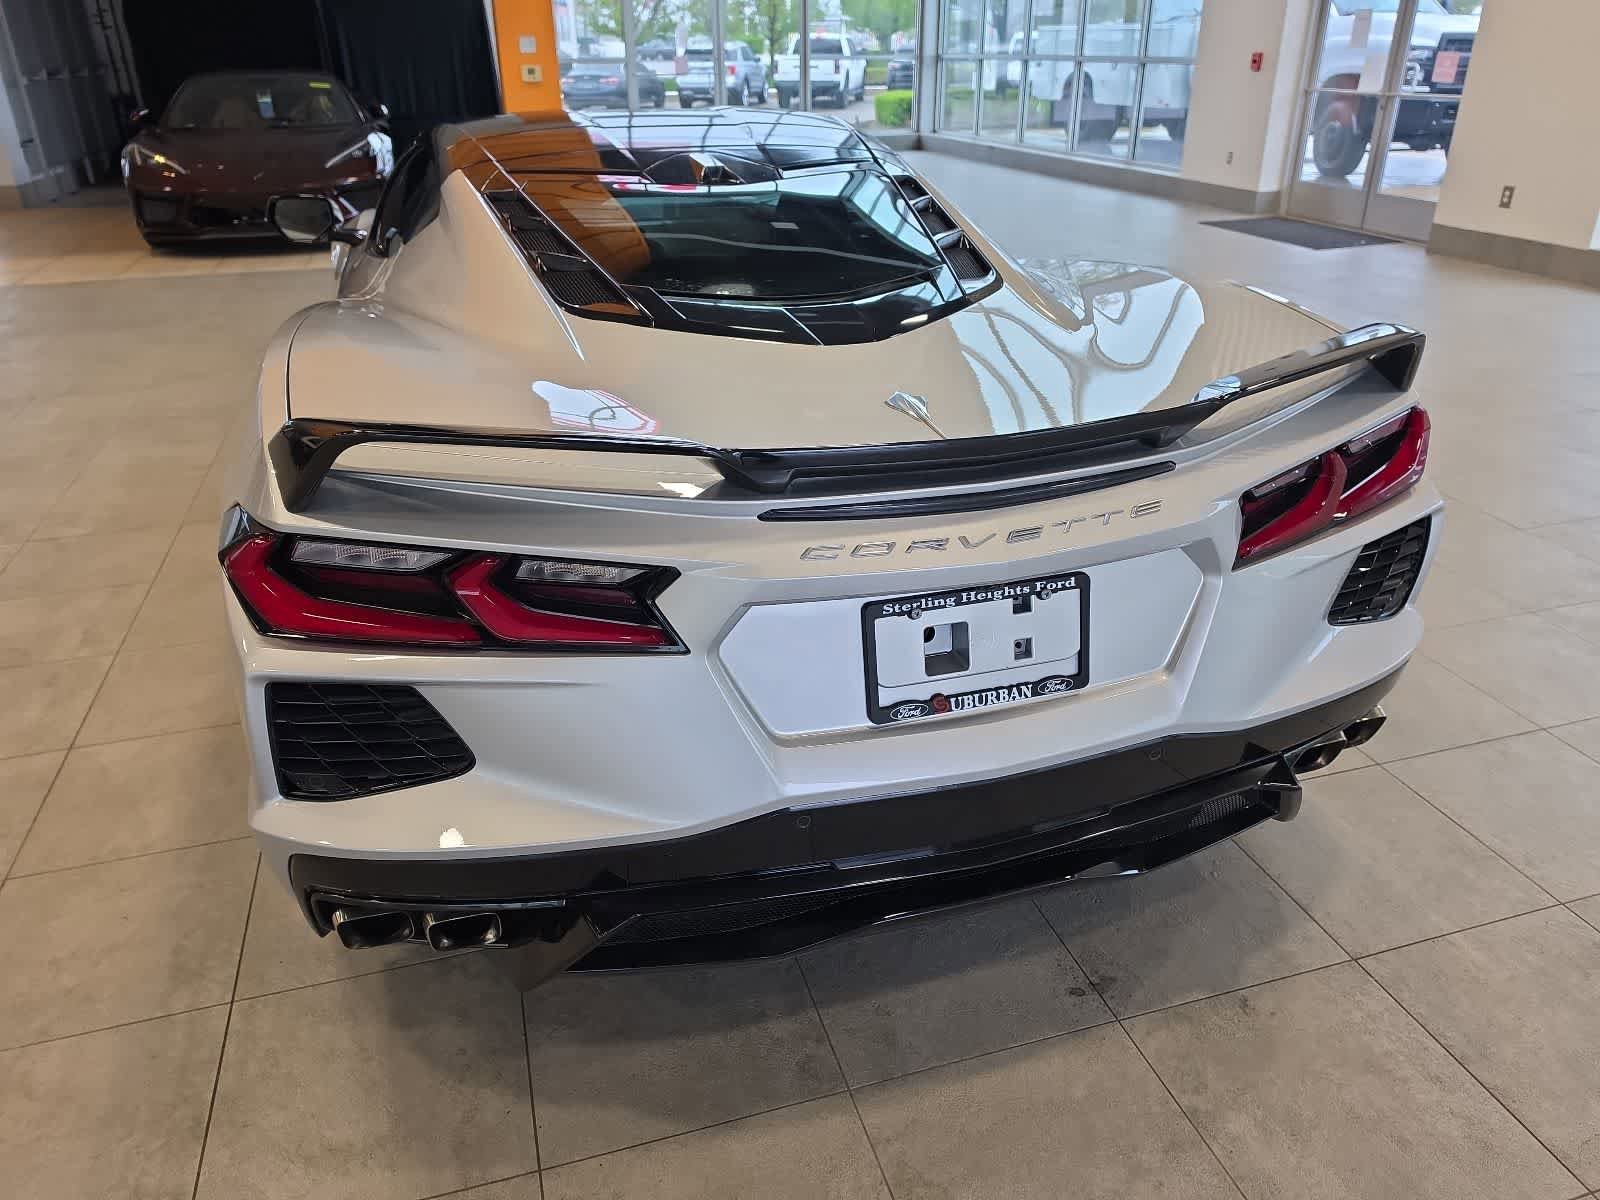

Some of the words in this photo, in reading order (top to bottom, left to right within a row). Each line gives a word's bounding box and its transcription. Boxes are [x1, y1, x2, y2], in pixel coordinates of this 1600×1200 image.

[800, 499, 1163, 560] CORVETTE
[882, 596, 956, 615] Sterling
[961, 585, 1030, 603] Heights
[1035, 577, 1076, 593] Ford
[896, 704, 922, 718] Ford
[932, 685, 1033, 714] SUBURBAN
[1044, 679, 1068, 692] Ford
